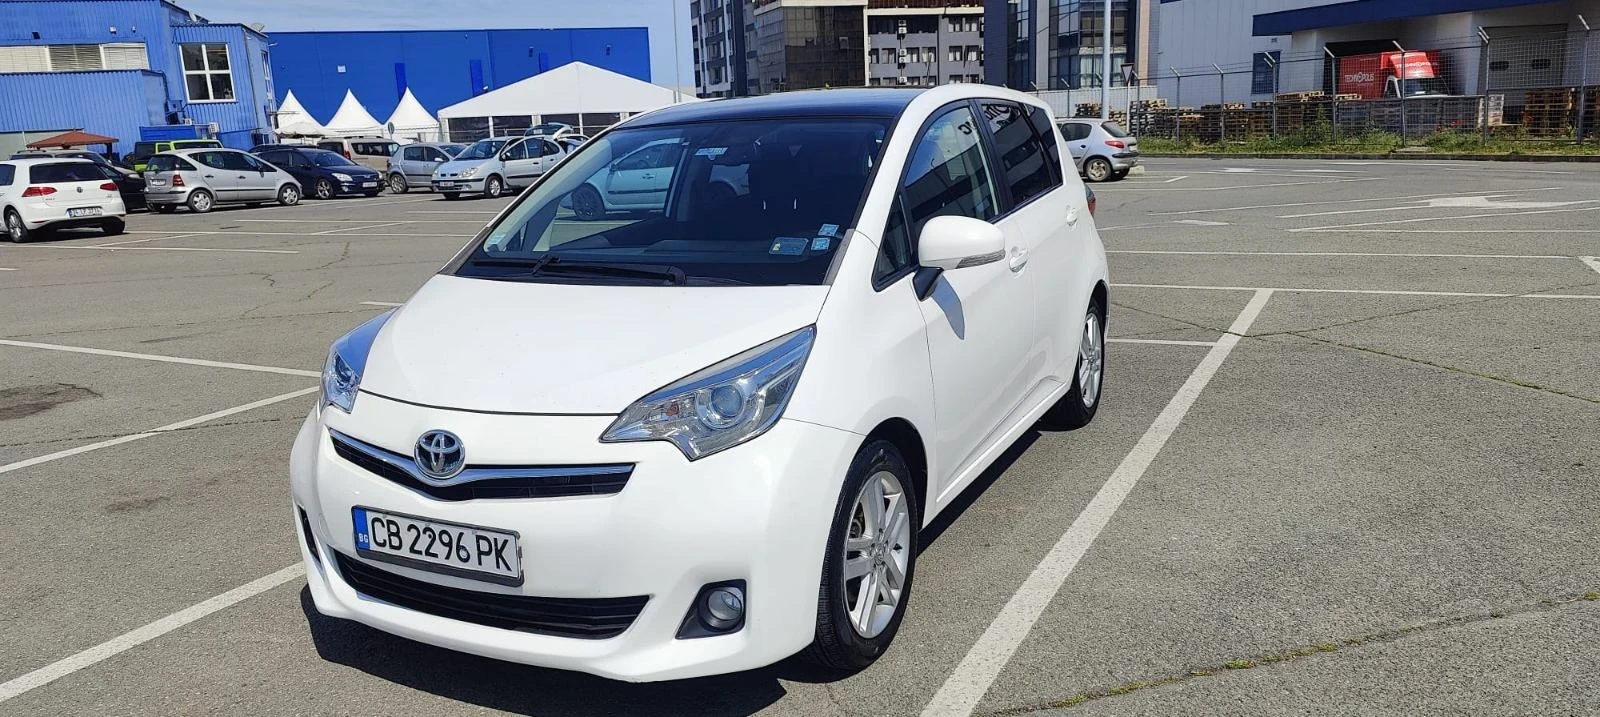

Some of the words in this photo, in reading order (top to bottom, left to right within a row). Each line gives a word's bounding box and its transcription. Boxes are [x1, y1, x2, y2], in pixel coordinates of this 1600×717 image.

[358, 532, 369, 543] BG
[371, 517, 402, 551] CB
[406, 523, 471, 563] 2296
[475, 534, 513, 571] PK
